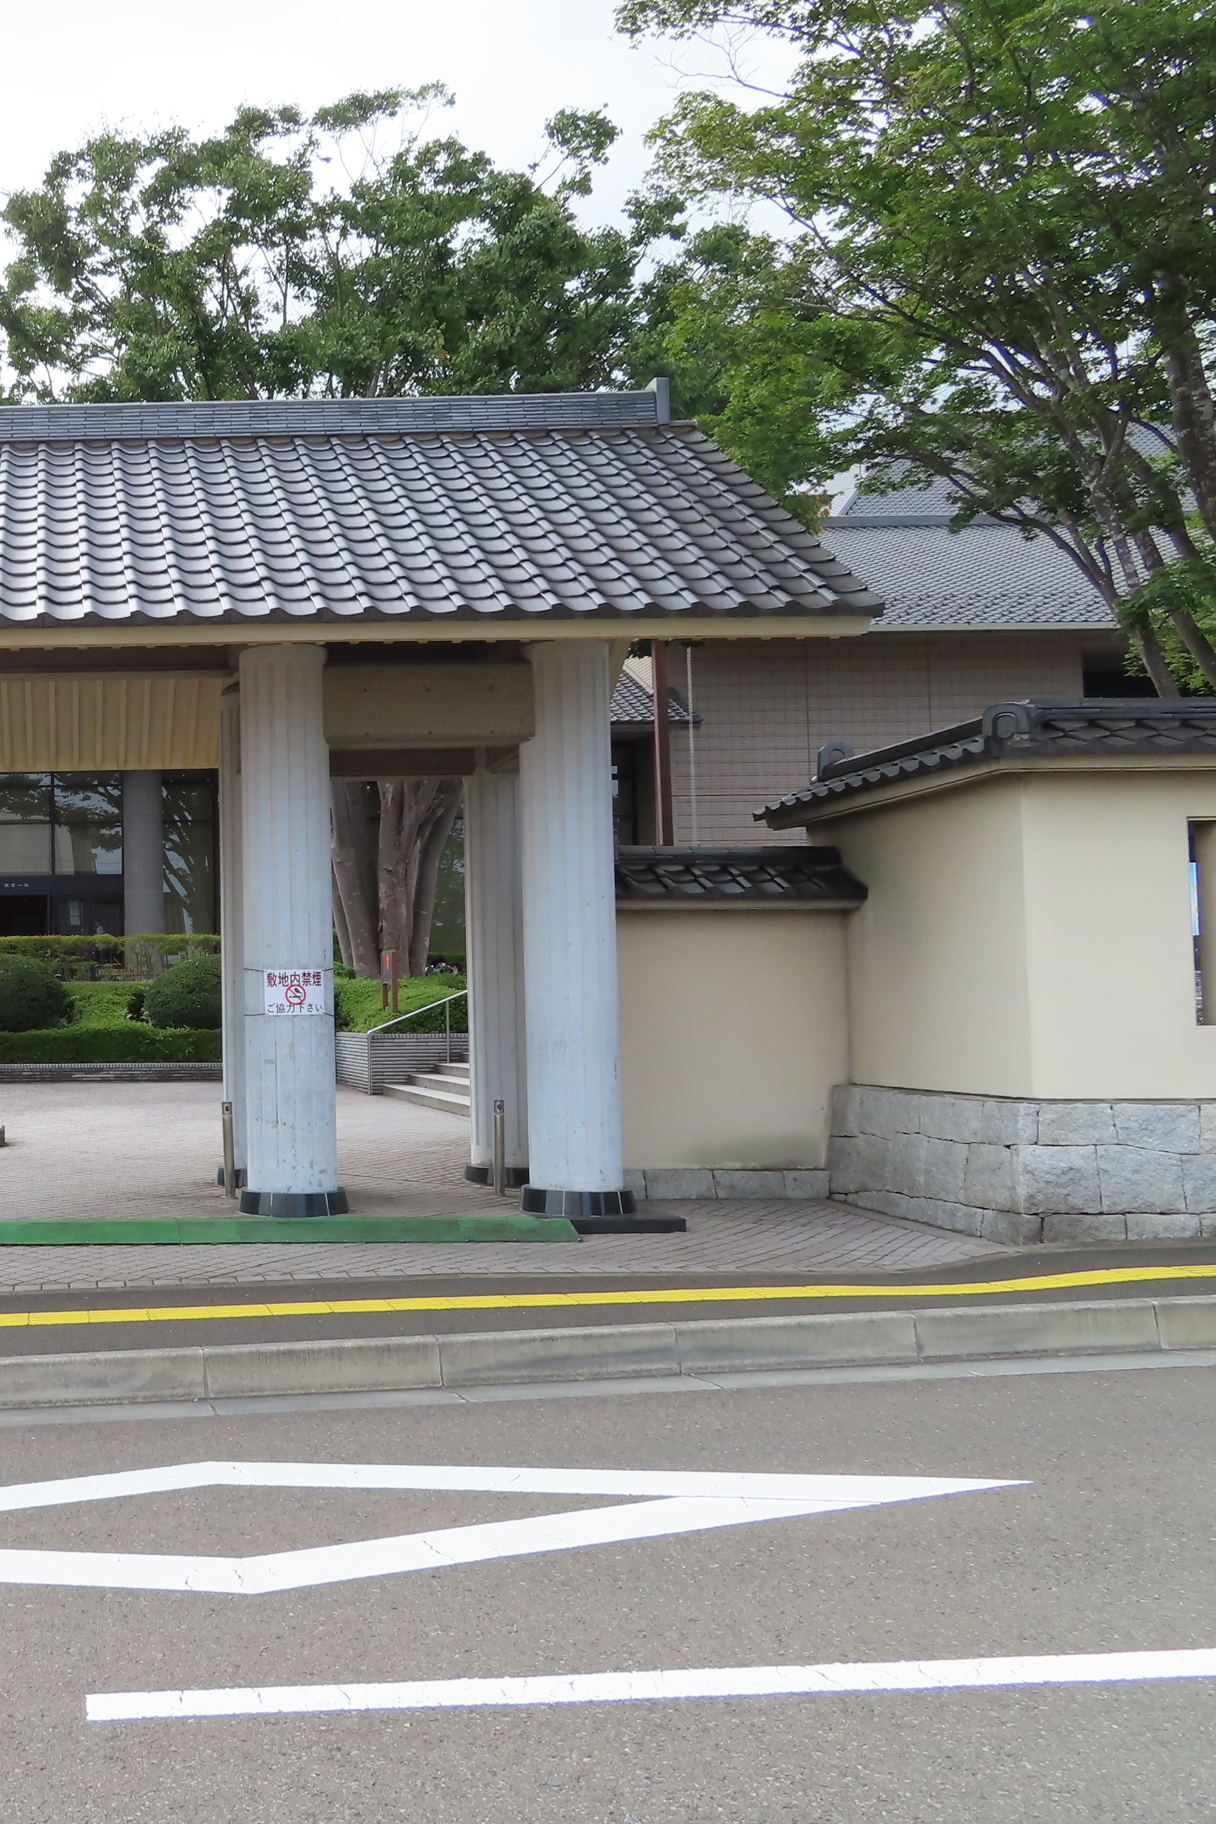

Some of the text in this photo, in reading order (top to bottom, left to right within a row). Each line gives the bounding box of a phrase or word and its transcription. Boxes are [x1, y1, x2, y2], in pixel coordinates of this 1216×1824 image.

[266, 971, 322, 988] 敷地内禁煙
[267, 1002, 323, 1014] ご協力下さい
